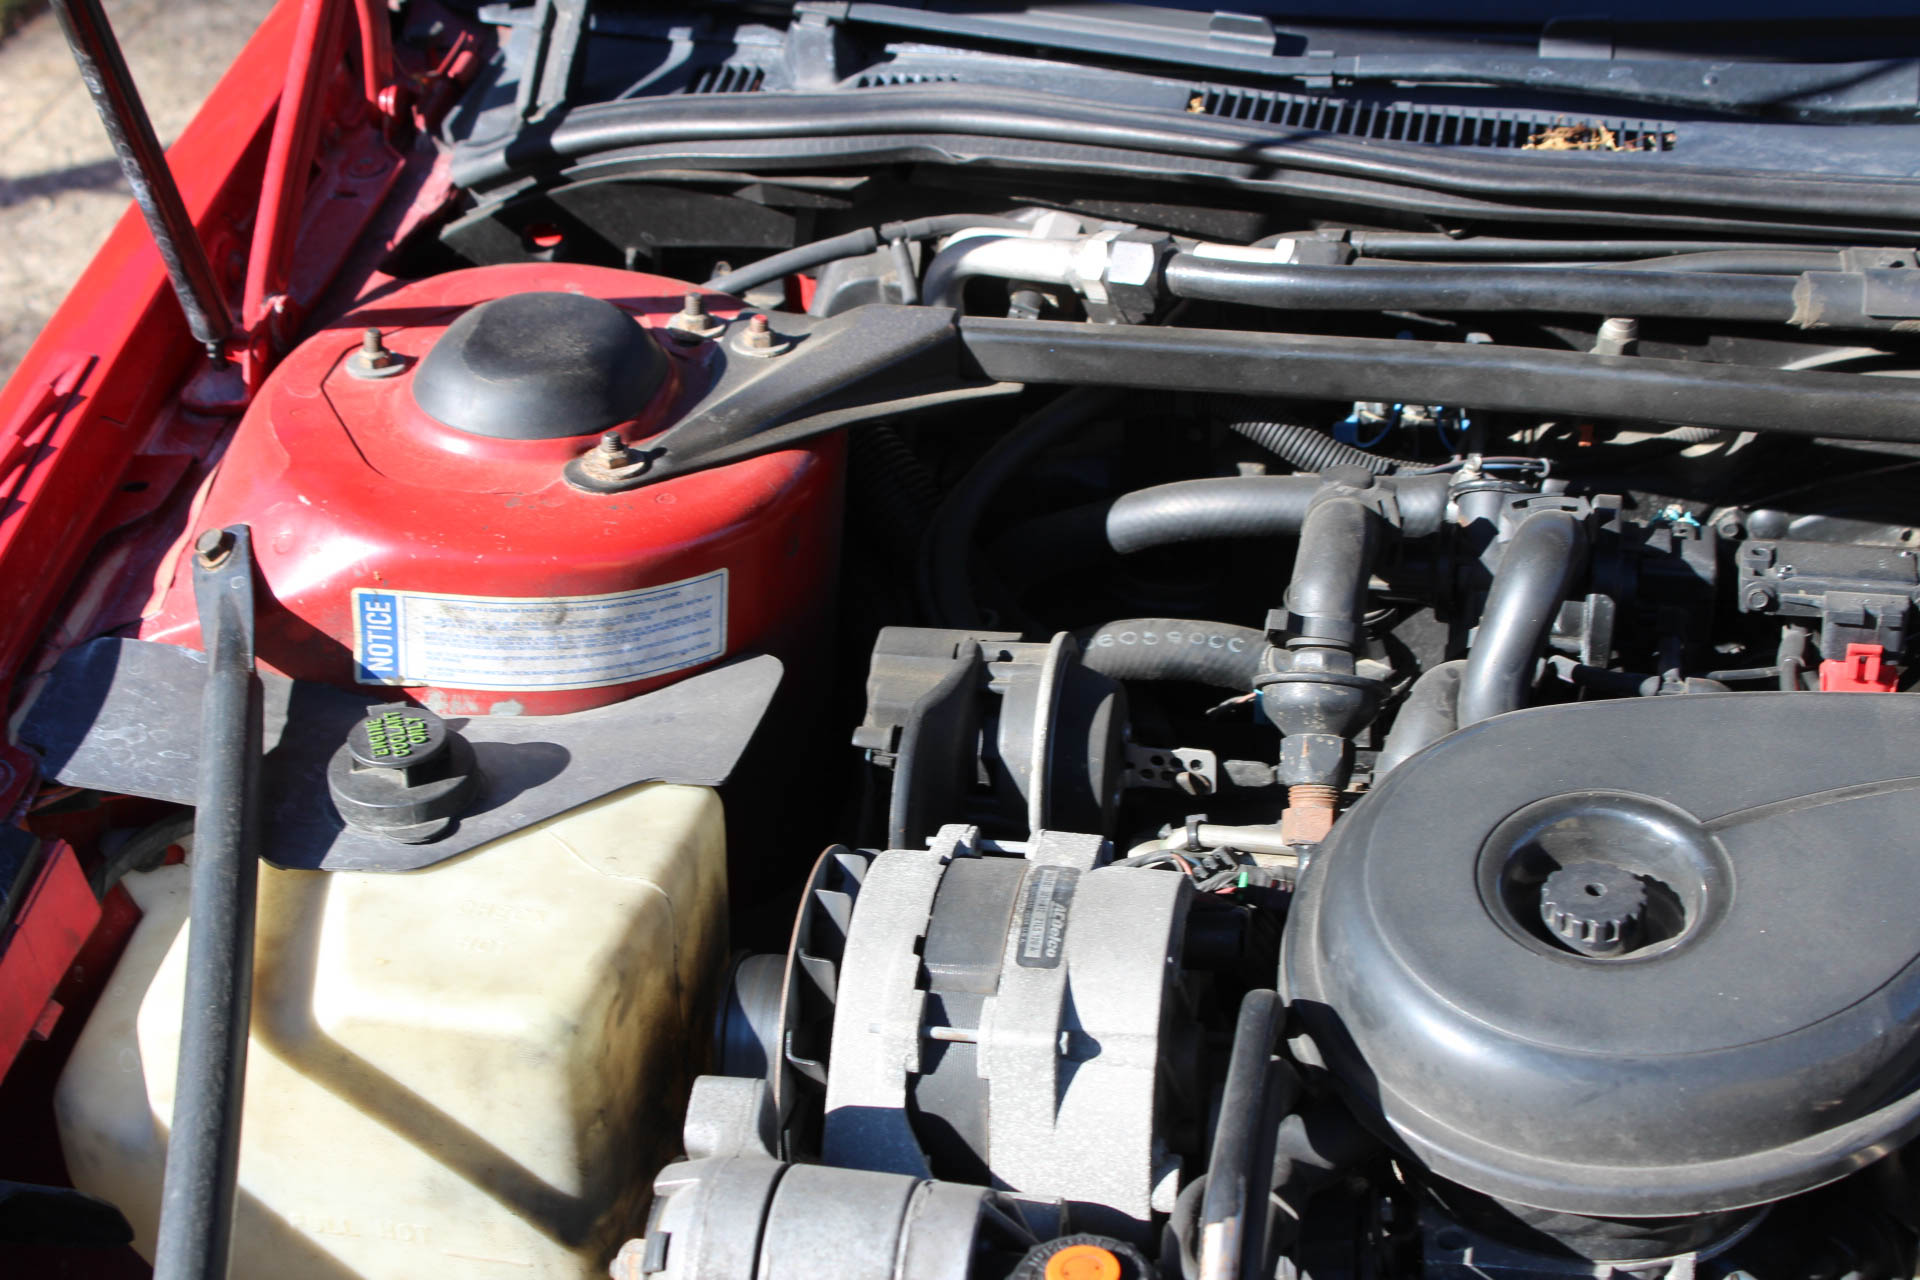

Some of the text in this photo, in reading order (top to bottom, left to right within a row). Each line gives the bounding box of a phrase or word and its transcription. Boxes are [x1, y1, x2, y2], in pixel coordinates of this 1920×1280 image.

[364, 600, 394, 673] NOTICE
[365, 717, 391, 757] ENGINE
[383, 711, 412, 757] COOLANT
[405, 717, 427, 745] ONLY
